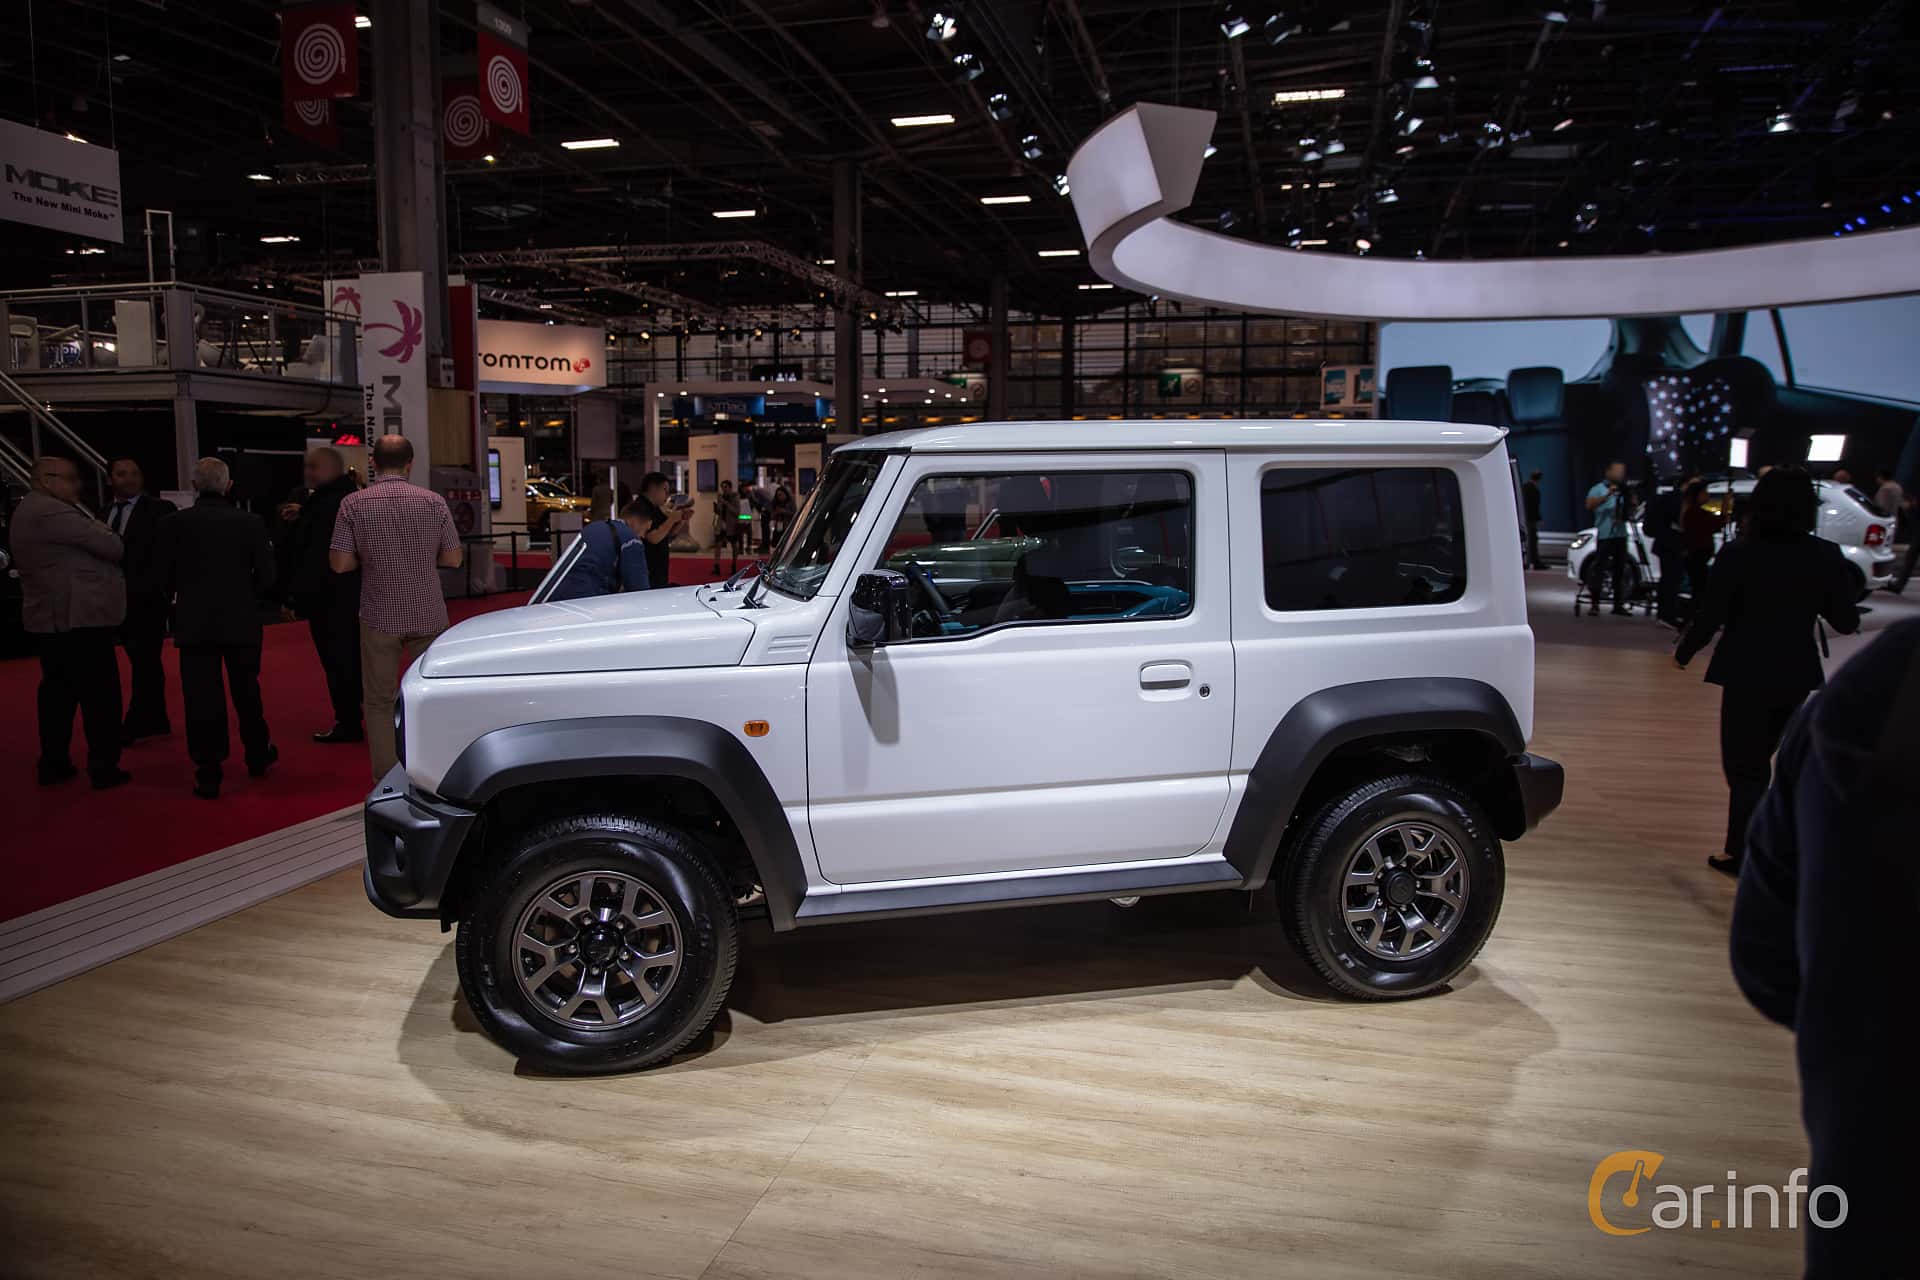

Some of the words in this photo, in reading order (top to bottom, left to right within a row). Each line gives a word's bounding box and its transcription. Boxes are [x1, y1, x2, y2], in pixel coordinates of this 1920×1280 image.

[5, 163, 119, 207] MOKE
[12, 191, 33, 203] The
[36, 197, 58, 209] New
[61, 202, 81, 214] Mini
[366, 383, 375, 410] The
[367, 416, 376, 448] New
